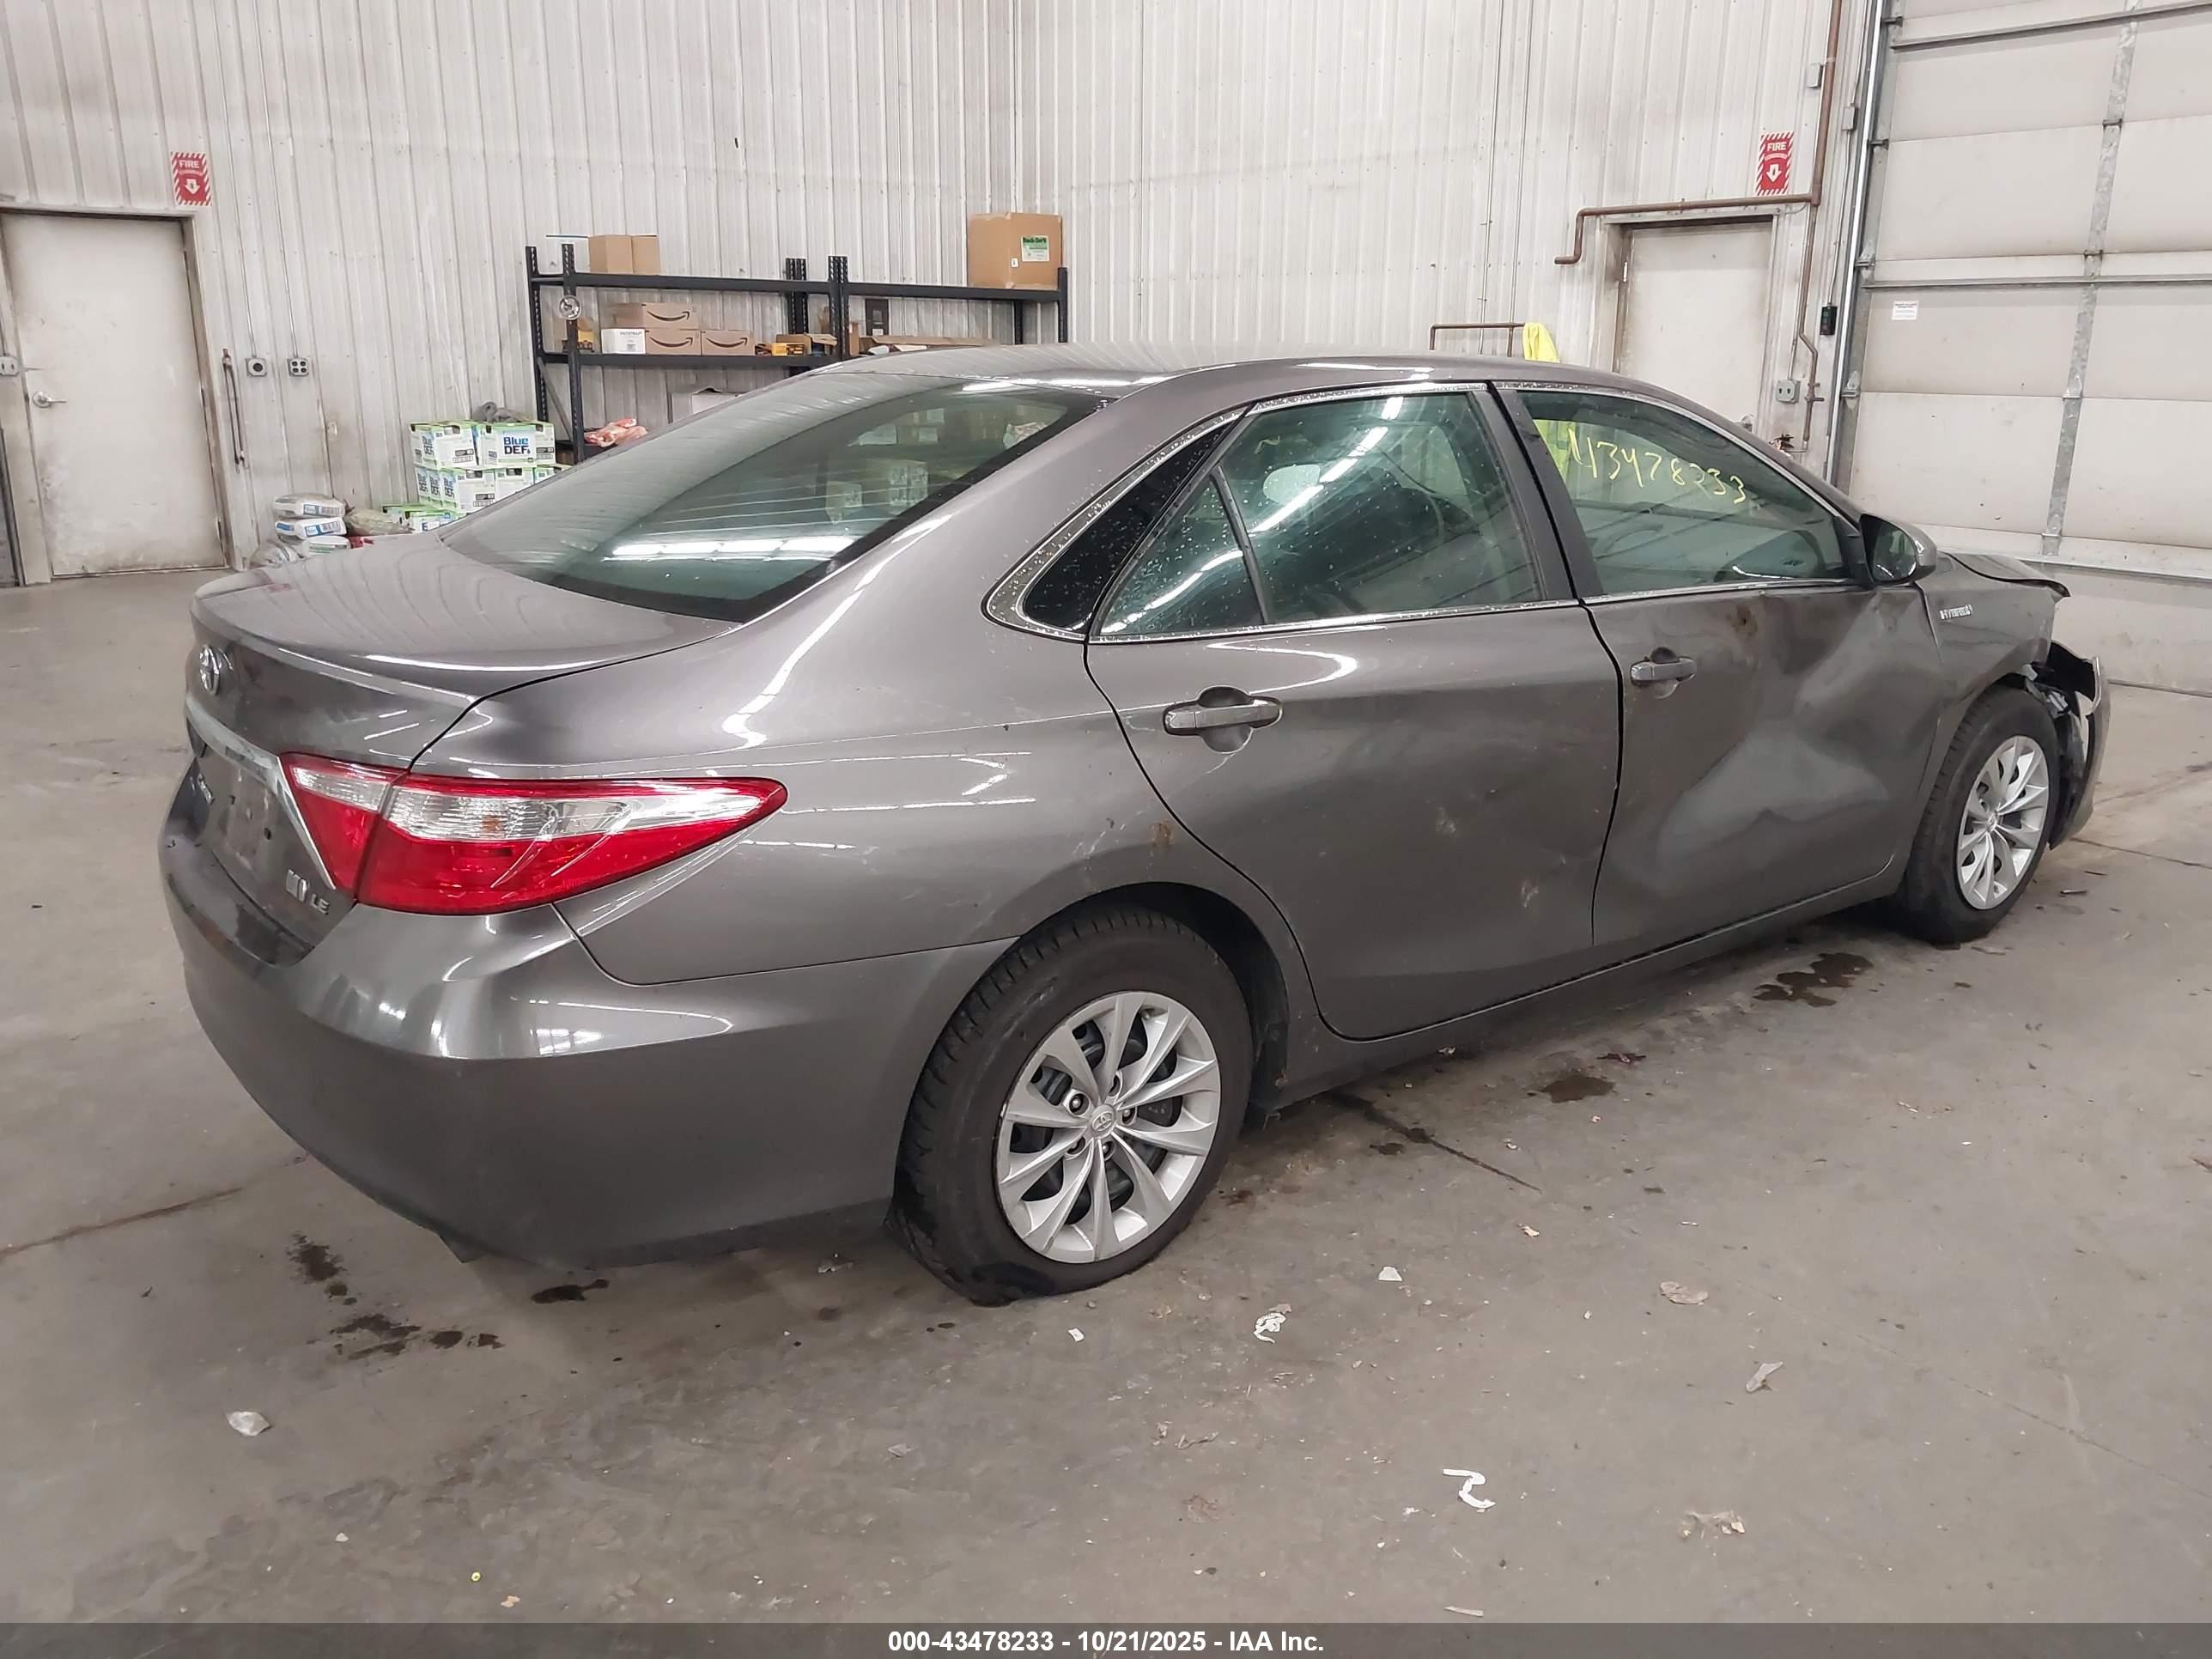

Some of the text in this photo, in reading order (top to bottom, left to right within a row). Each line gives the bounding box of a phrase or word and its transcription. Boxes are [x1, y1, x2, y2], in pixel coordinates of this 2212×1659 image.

[1767, 142, 1787, 151] FIRE
[179, 160, 199, 168] FIRE
[503, 436, 529, 445] Blue
[504, 446, 528, 455] DEF
[1567, 428, 1747, 504] 43478233
[310, 893, 331, 915] LE
